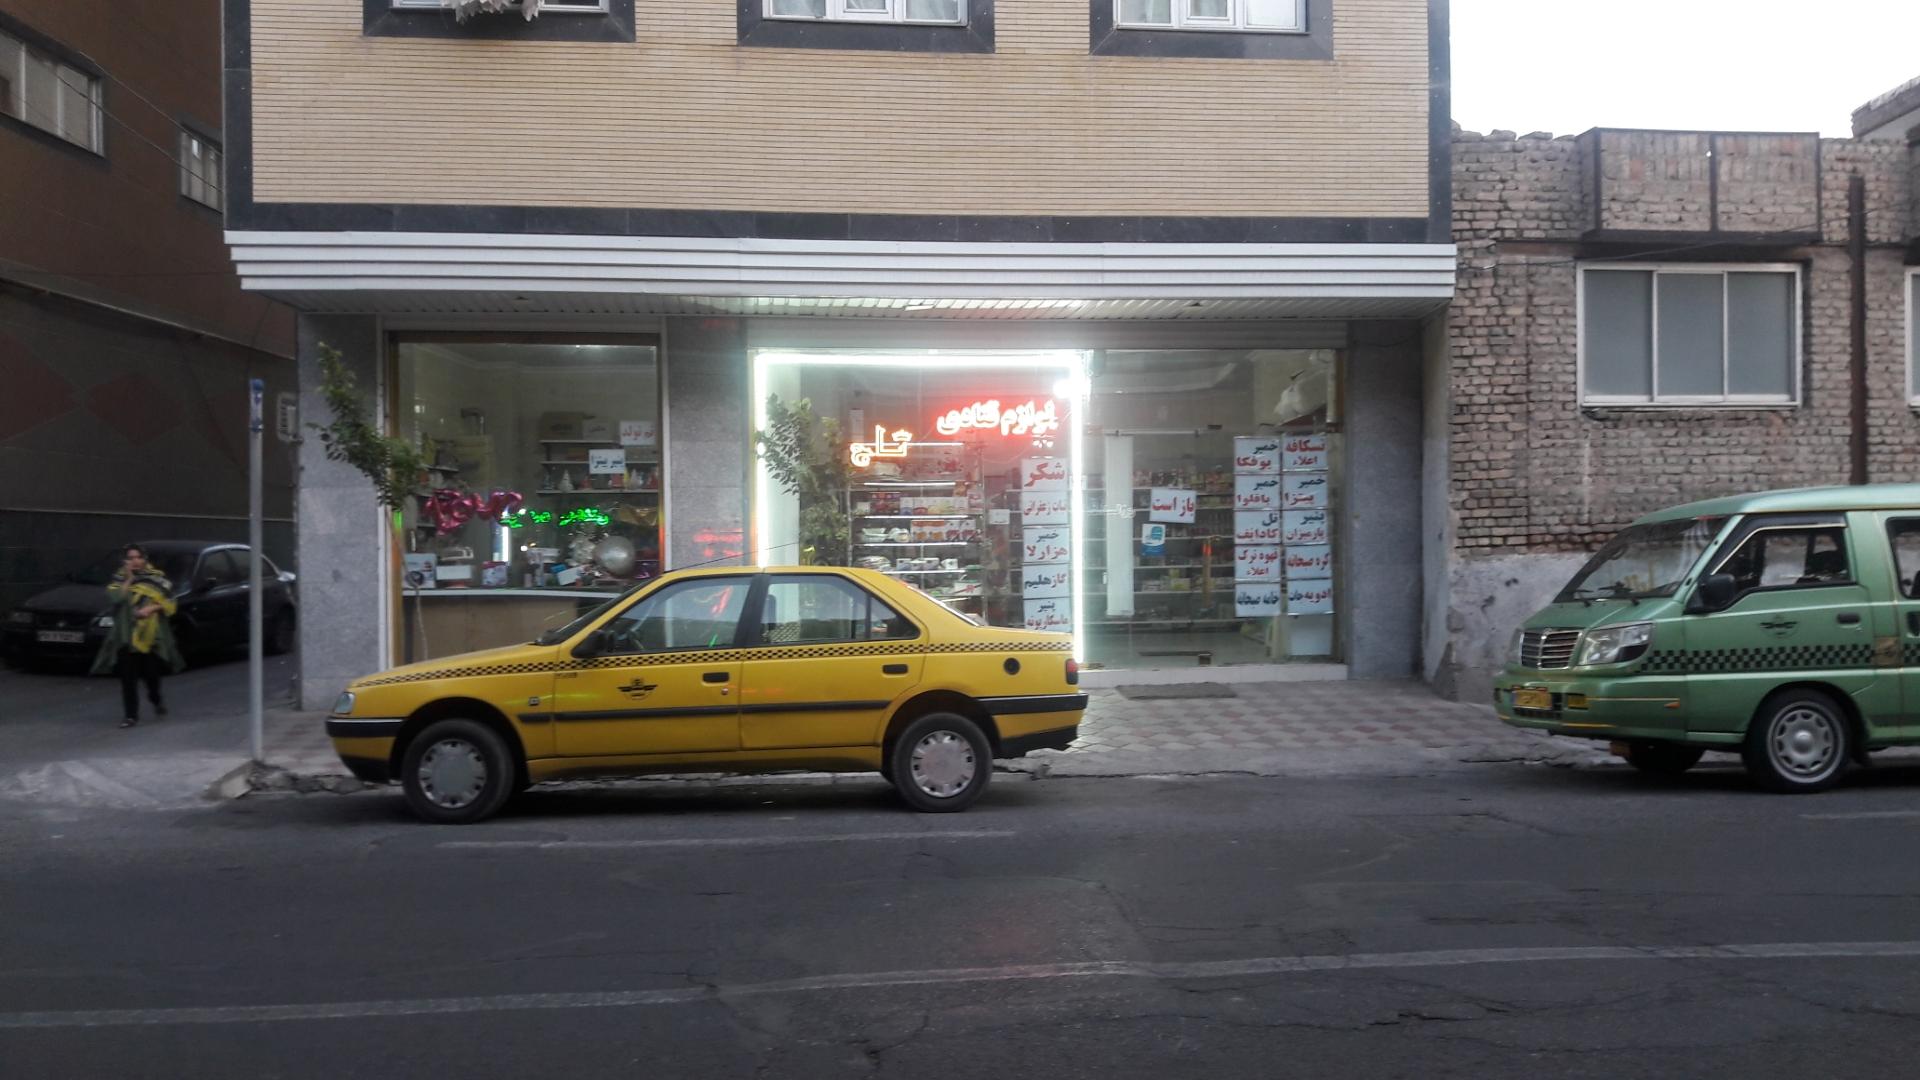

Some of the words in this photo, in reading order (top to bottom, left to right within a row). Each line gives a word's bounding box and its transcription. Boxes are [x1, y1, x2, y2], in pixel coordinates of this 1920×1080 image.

[937, 399, 1000, 435] قنادی
[1000, 399, 1059, 436] لوازم
[849, 424, 913, 467] تاج
[1252, 440, 1278, 455] خمیر
[1285, 438, 1325, 453] نسکافه
[1023, 461, 1066, 488] شکر
[1297, 475, 1326, 489] خمیر
[1253, 476, 1279, 491] خمیر
[1151, 496, 1177, 511] است
[1179, 496, 1194, 517] باز
[1284, 492, 1315, 506] پیتزا
[1299, 511, 1325, 526] پنیر
[1036, 529, 1059, 543] خمیر
[1258, 547, 1279, 564] قهوه
[1037, 600, 1056, 614] پنیر
